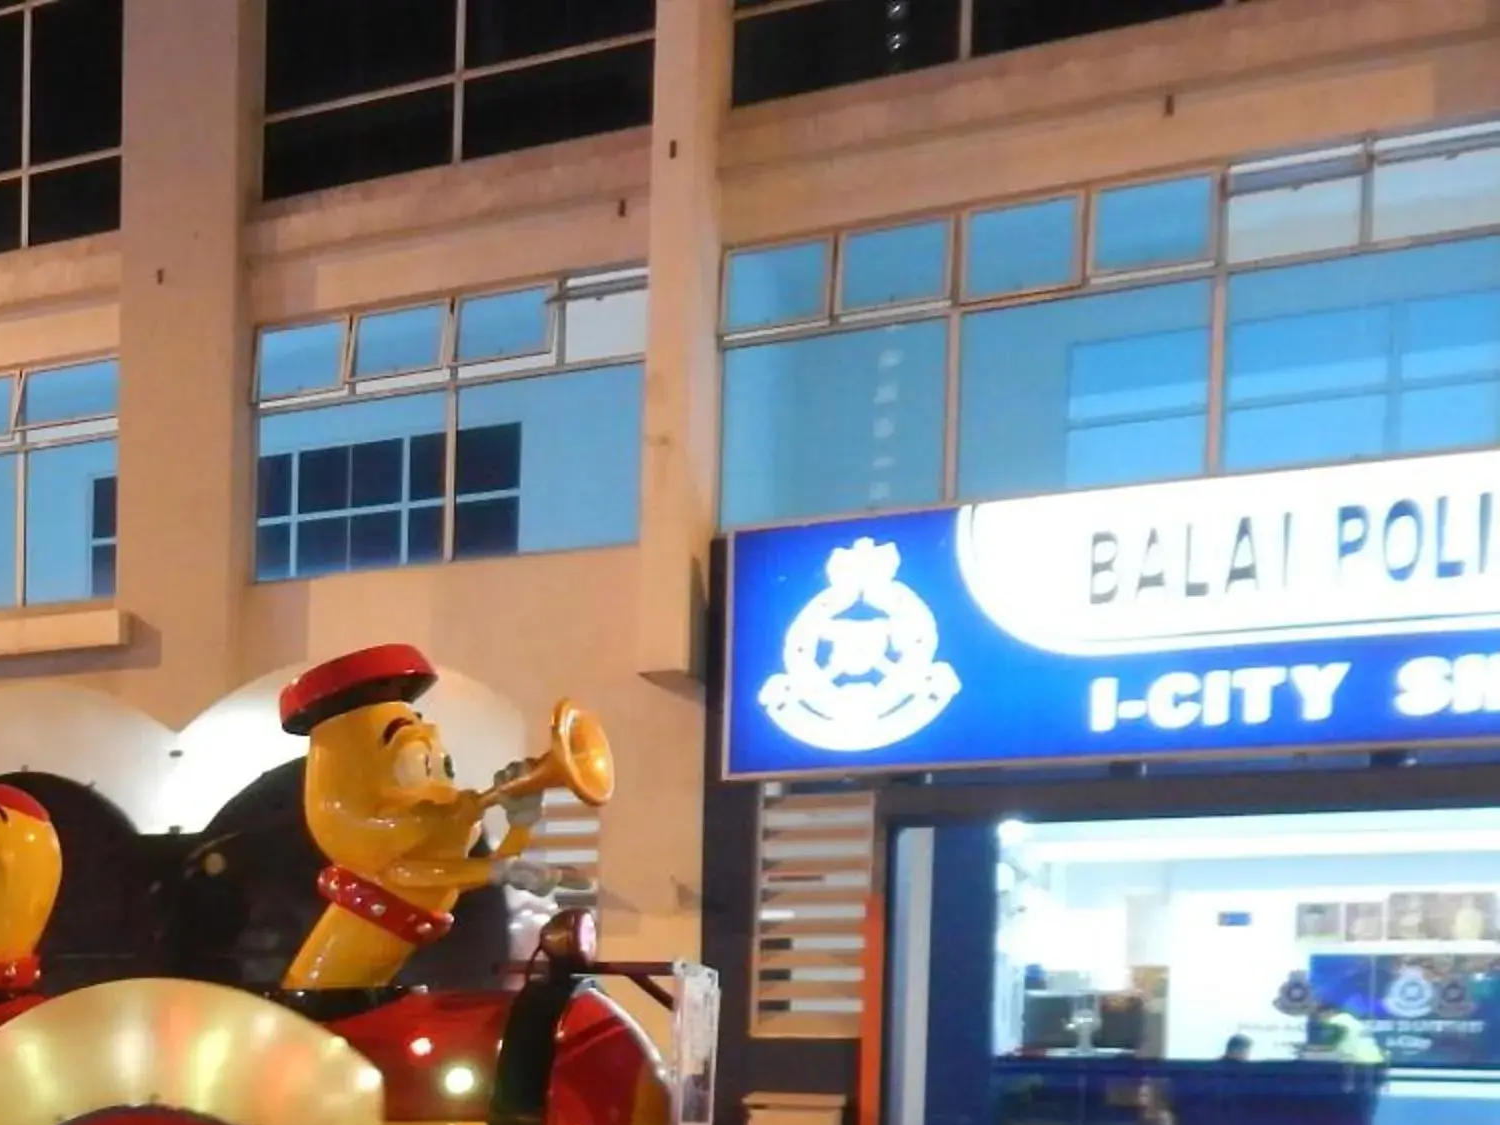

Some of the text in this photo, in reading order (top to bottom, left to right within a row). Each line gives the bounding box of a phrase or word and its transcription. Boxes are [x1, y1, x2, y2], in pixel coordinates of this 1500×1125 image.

[1089, 492, 1493, 605] BALAI POLI
[1089, 661, 1352, 733] I-CITY
